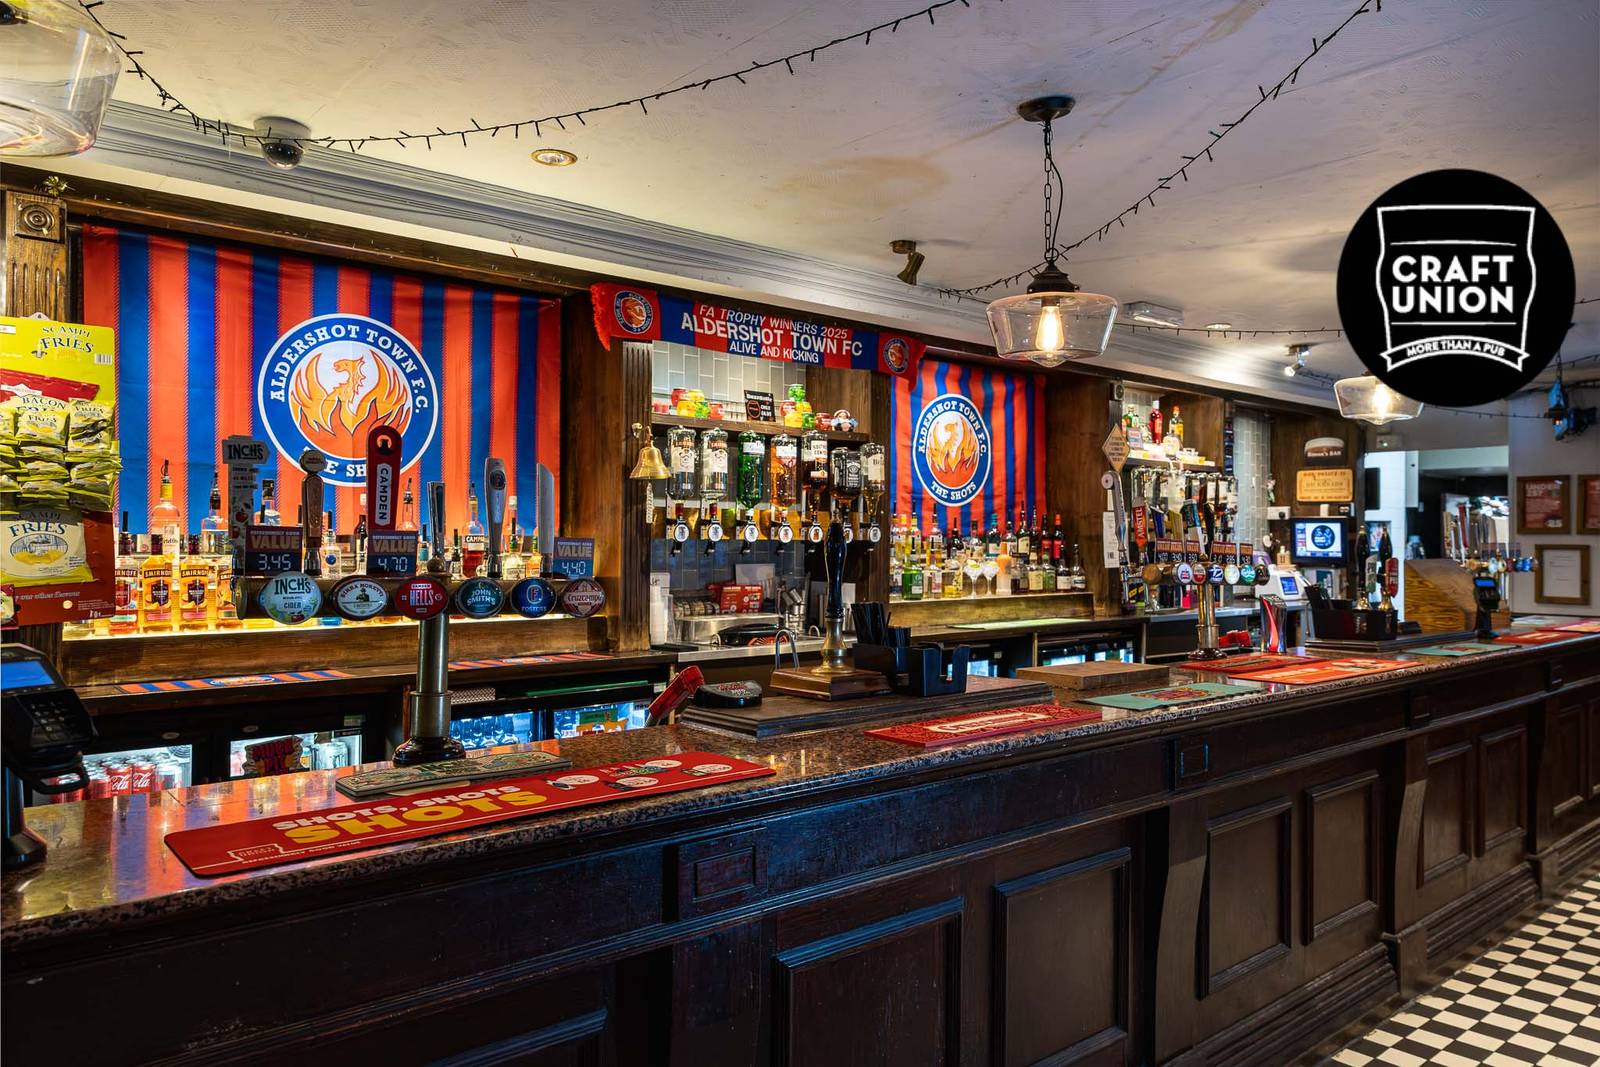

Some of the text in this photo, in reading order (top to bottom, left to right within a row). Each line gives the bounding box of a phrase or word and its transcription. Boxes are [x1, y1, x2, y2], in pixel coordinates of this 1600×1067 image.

[700, 304, 848, 340] FA TROPHY WINNERS 2025
[42, 326, 91, 338] SCAMPI
[681, 312, 784, 346] ALDERSHOT
[790, 331, 837, 354] TOWN
[842, 340, 863, 356] FC
[41, 337, 94, 353] FRIES
[729, 340, 819, 364] ALIVE AND KICKING
[270, 324, 429, 414] ALDERSHOT TOWN F.C.
[22, 396, 66, 410] BACON
[918, 400, 958, 454] ALDERSHOT
[959, 402, 980, 431] TOWN
[227, 444, 264, 460] INCH'S
[378, 467, 389, 520] CAMDEN
[930, 481, 977, 500] THE SHOTS
[8, 520, 68, 537] FRIES
[1134, 508, 1145, 539] AMSTEL
[251, 535, 300, 550] VALUE
[373, 540, 416, 553] VALUE
[557, 545, 592, 558] VALUE
[258, 553, 292, 571] 3.45
[378, 556, 408, 572] 4.70
[561, 561, 586, 575] 4.40
[274, 577, 312, 595] INCH'S
[472, 588, 491, 596] JOHN
[283, 601, 302, 609] CIDER
[409, 589, 434, 606] HELLS
[272, 785, 522, 831] SHOTS, SHOTS
[284, 791, 548, 844] SHOTS
